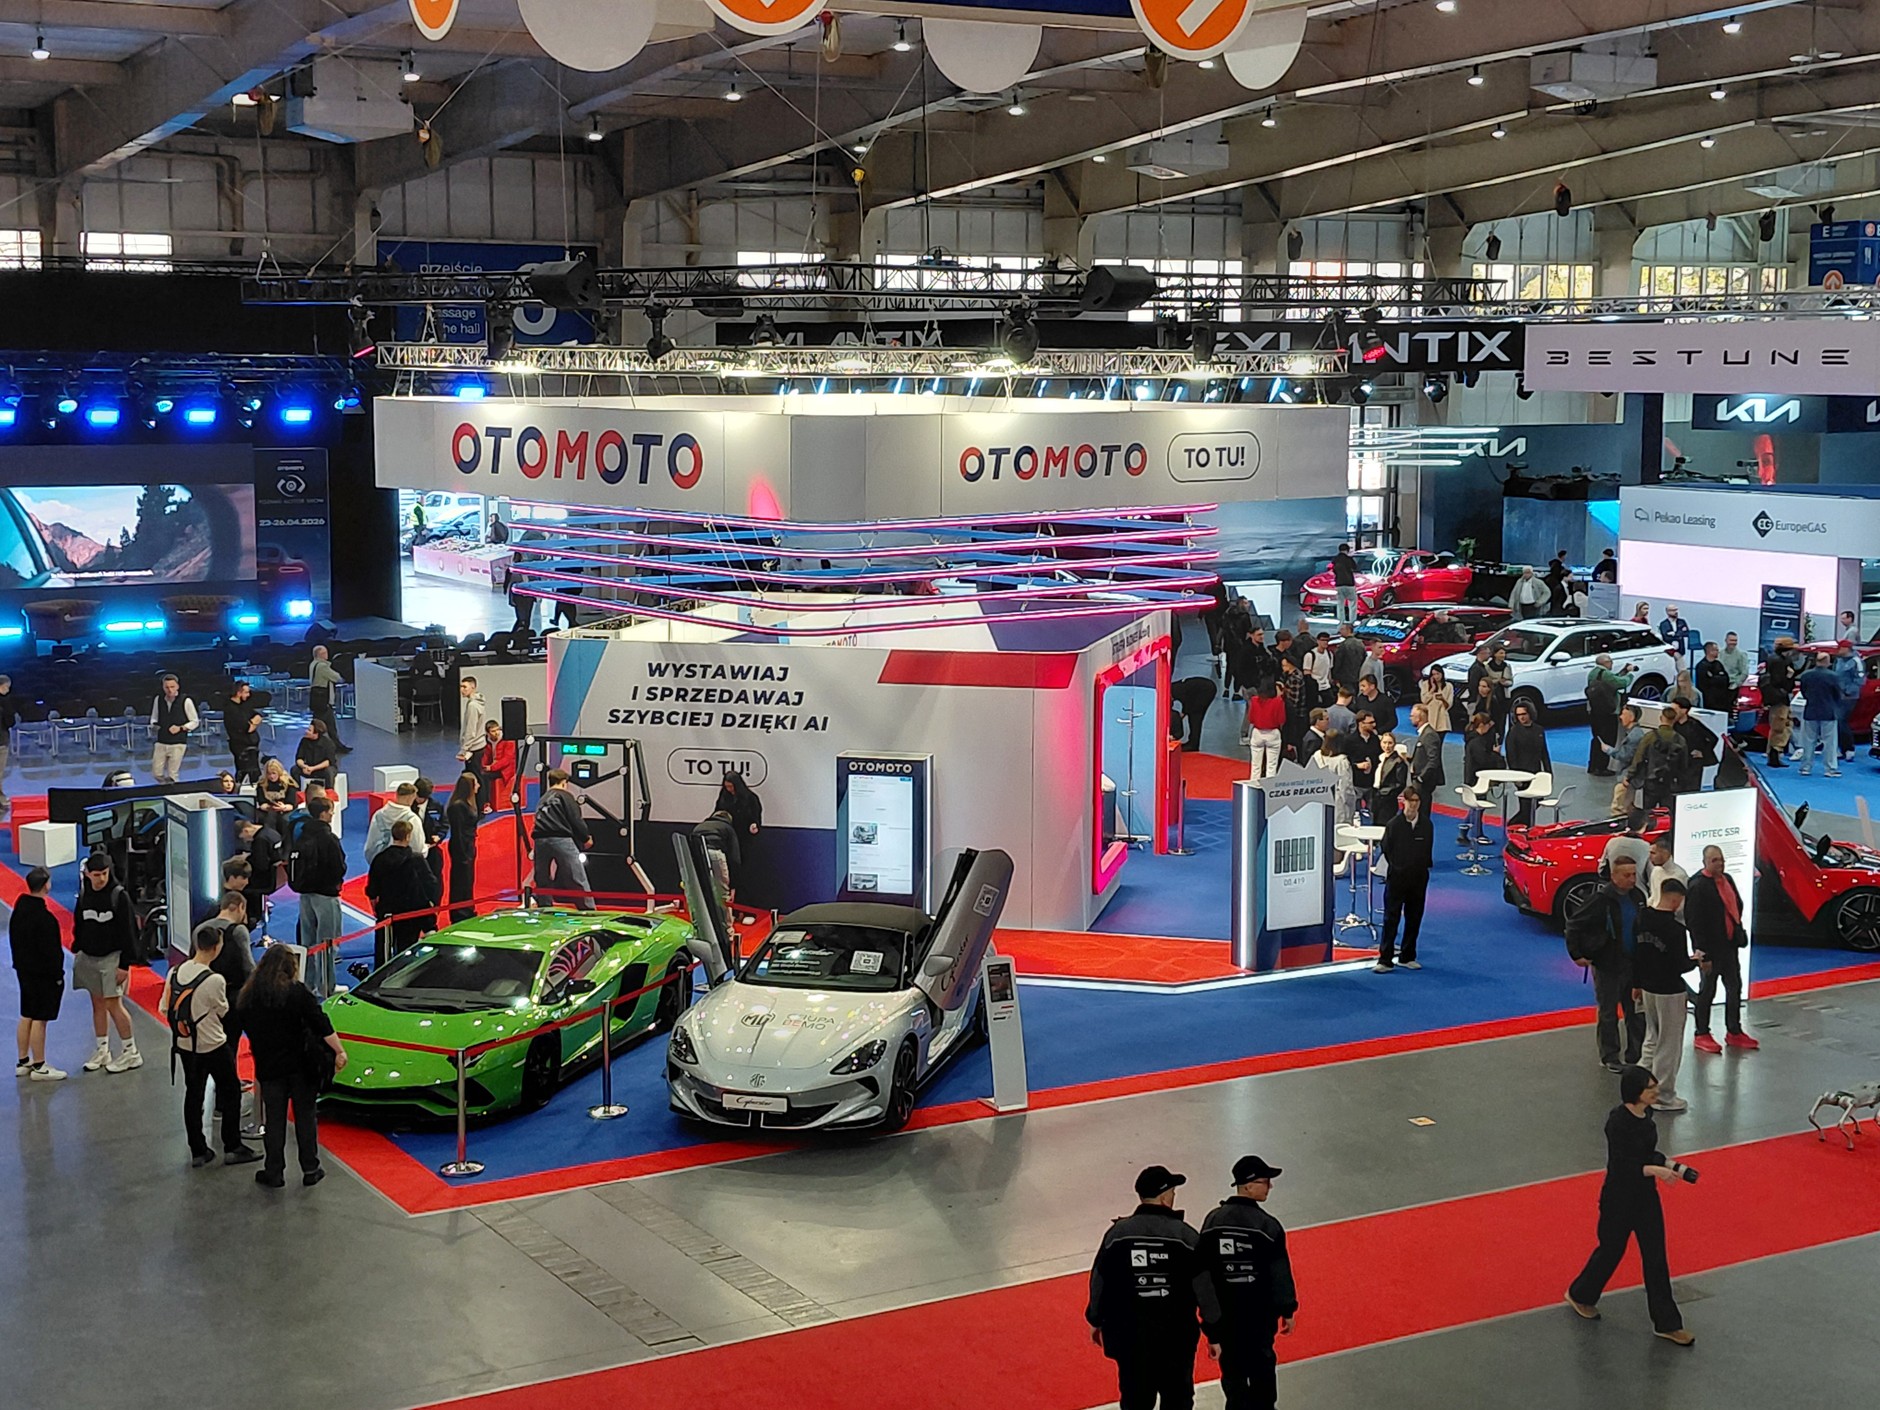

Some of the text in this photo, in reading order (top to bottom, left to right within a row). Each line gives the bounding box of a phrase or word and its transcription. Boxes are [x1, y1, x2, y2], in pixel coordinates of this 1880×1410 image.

[438, 308, 477, 321] ssage
[443, 322, 458, 334] he
[1545, 349, 1851, 366] BESTUNE
[452, 422, 703, 490] OTOMOTO
[959, 442, 1148, 483] OTOMOTO
[1183, 446, 1246, 469] TO TU!
[1654, 512, 1716, 529] Pekao Leasing
[1775, 519, 1828, 534] EuropeGAS
[647, 662, 790, 682] WYSTAWIAJ
[631, 685, 804, 706] I SPRZEDAWAJ
[607, 708, 829, 734] SZYBCIEJ DZIĘKI AI
[684, 758, 751, 777] TO TU!
[848, 761, 913, 774] OTOMOTO
[1268, 786, 1329, 798] CZAS REAKCJI
[1690, 828, 1723, 839] HYPTEC
